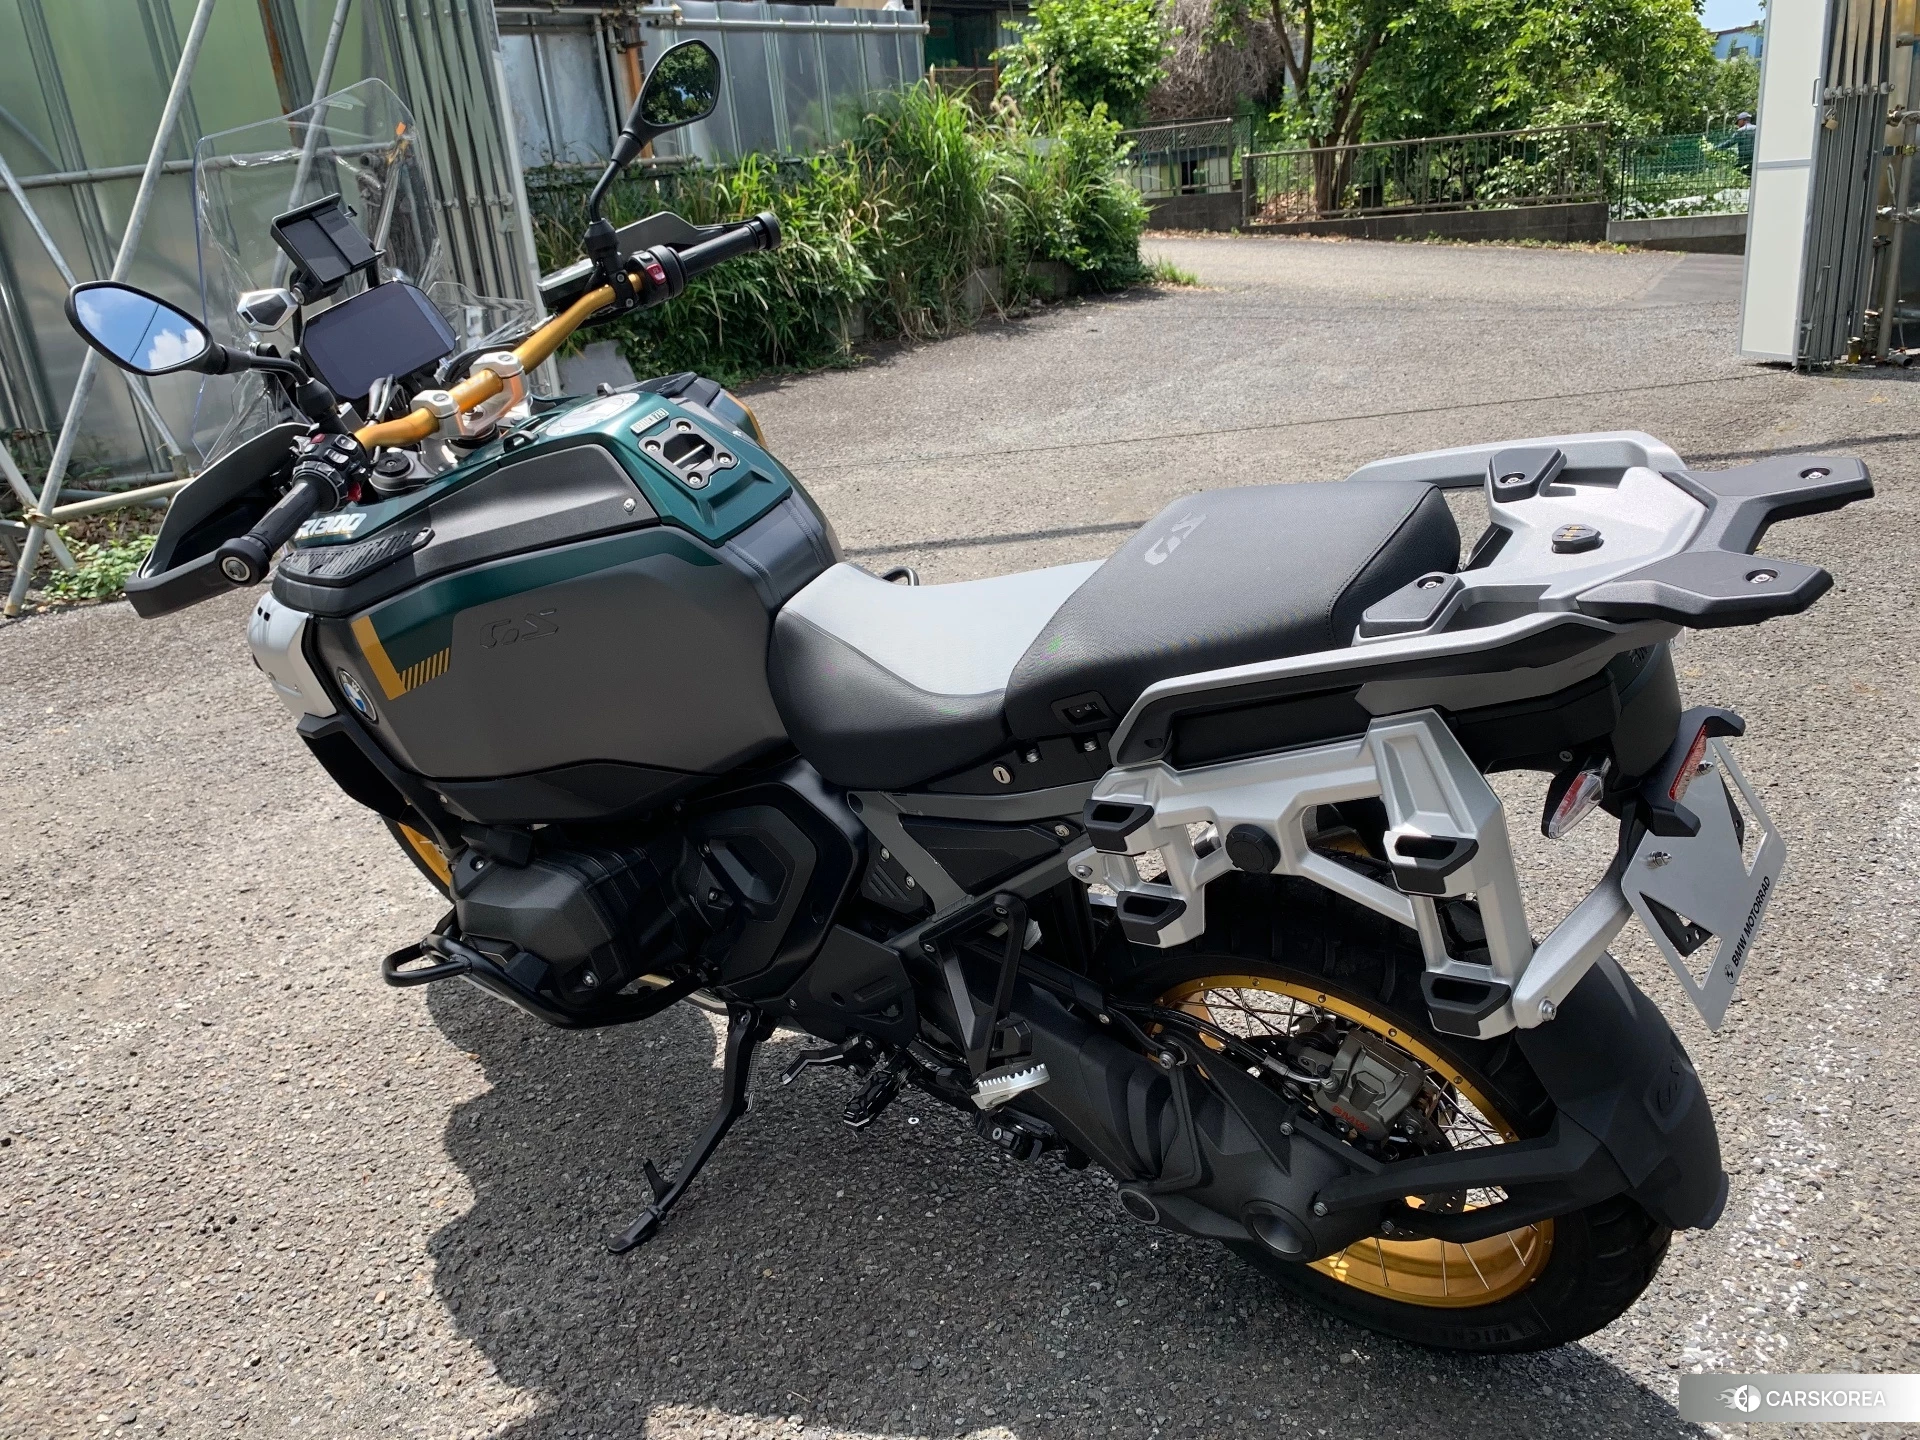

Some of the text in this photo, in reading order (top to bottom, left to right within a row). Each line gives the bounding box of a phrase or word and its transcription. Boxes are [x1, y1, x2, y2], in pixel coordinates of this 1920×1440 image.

[1144, 511, 1207, 565] GS
[480, 608, 559, 649] GS
[1731, 875, 1771, 968] BMW MOTORRAD
[1331, 1104, 1369, 1132] BMW
